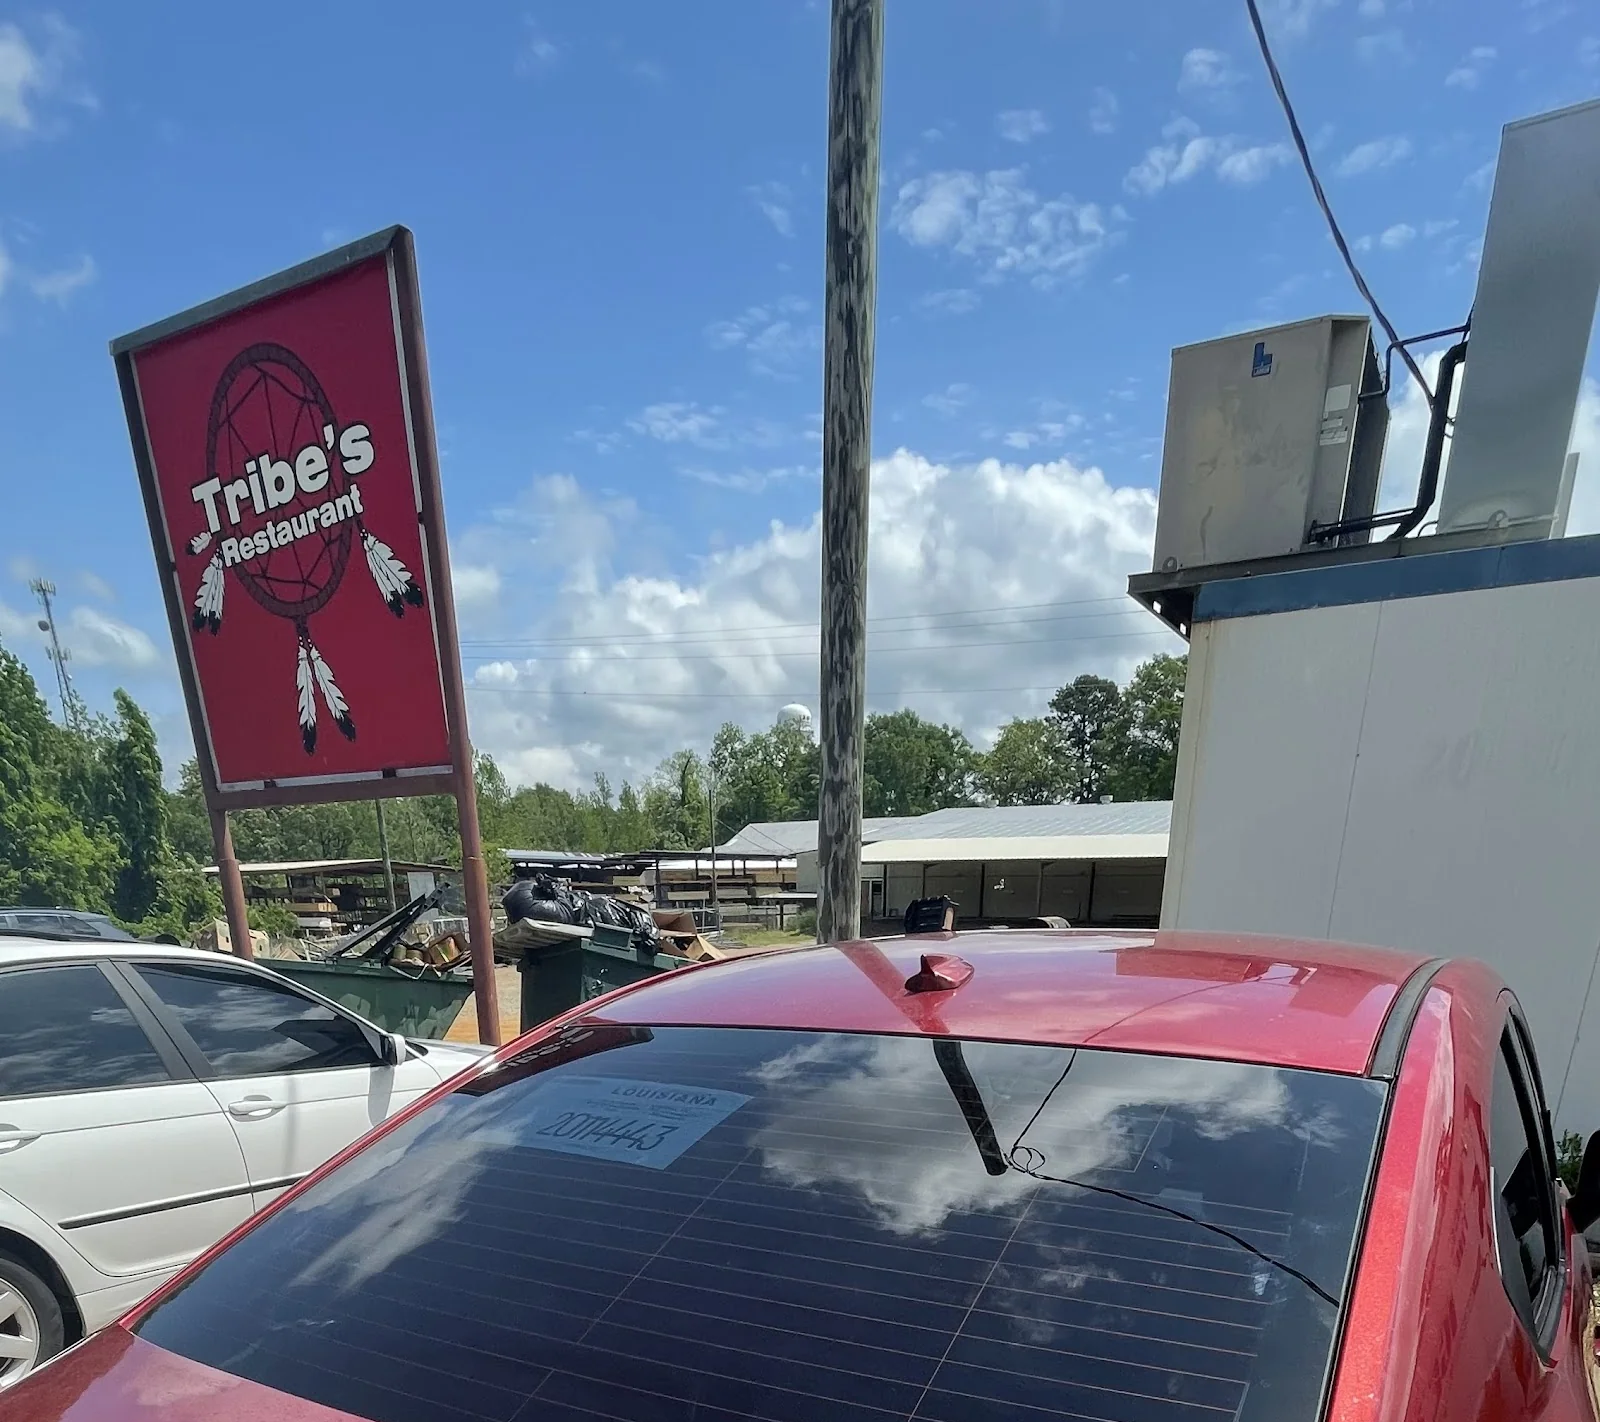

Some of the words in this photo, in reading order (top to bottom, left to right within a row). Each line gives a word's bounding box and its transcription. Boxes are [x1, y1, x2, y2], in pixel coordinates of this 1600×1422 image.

[192, 423, 375, 534] Tribe's
[221, 483, 364, 567] Restaurant
[611, 1086, 718, 1107] LOUISIANA
